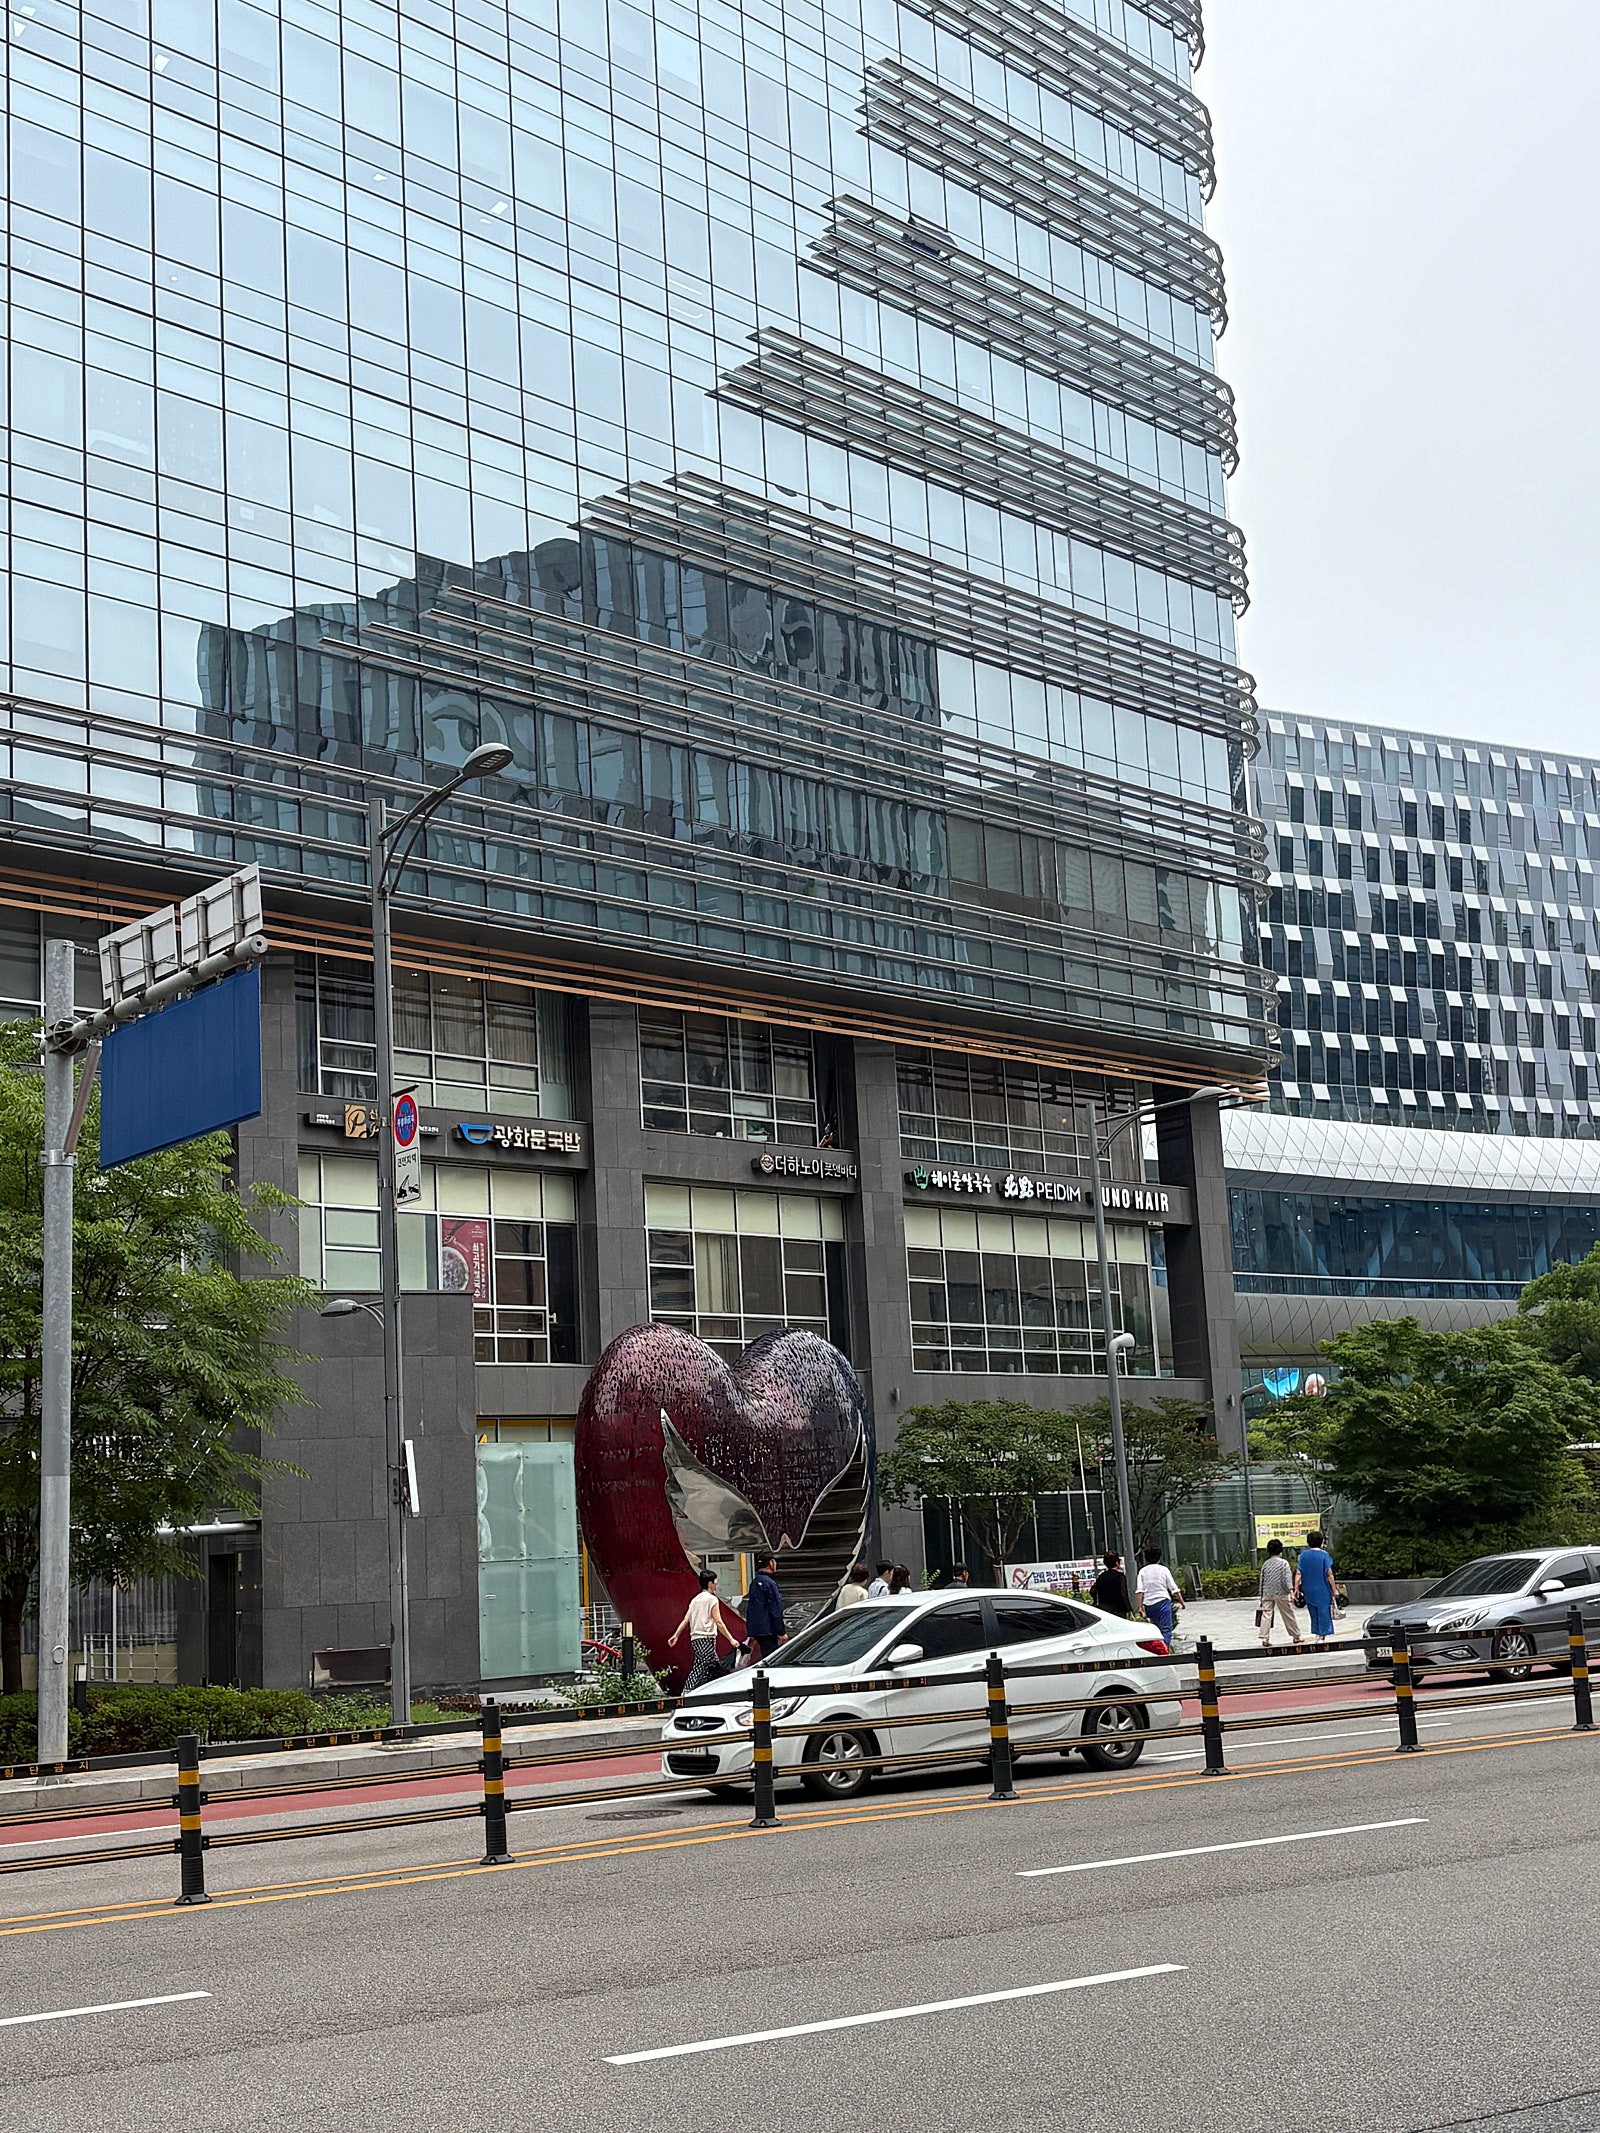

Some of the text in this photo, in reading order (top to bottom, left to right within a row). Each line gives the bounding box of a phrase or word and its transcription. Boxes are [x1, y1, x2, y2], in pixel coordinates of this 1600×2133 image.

[493, 1125, 581, 1152] 광화문국밥
[1036, 1181, 1081, 1202] PEIDIM
[1134, 1190, 1169, 1212] HAIR
